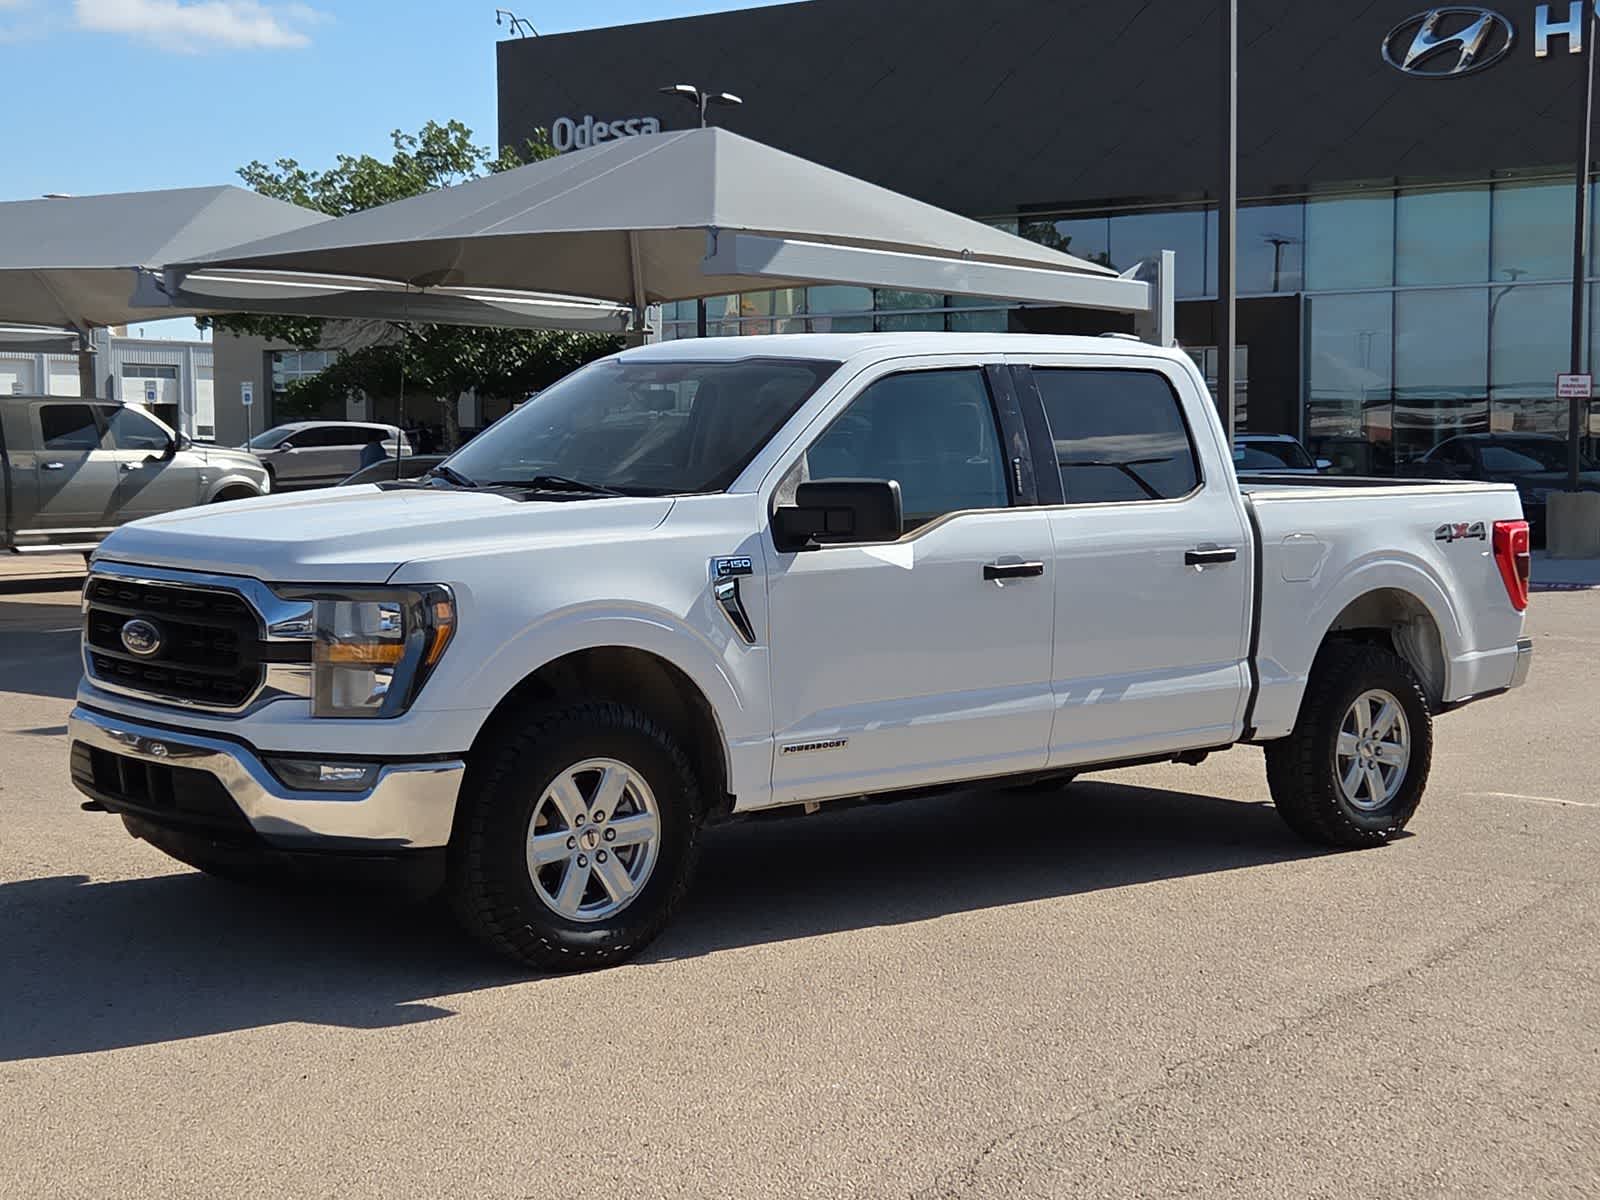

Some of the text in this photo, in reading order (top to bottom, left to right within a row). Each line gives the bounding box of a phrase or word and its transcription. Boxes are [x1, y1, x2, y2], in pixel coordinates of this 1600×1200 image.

[1535, 1, 1600, 57] H
[552, 115, 660, 151] Odessa
[718, 559, 751, 569] F-150
[783, 739, 847, 753] POWERBOOST
